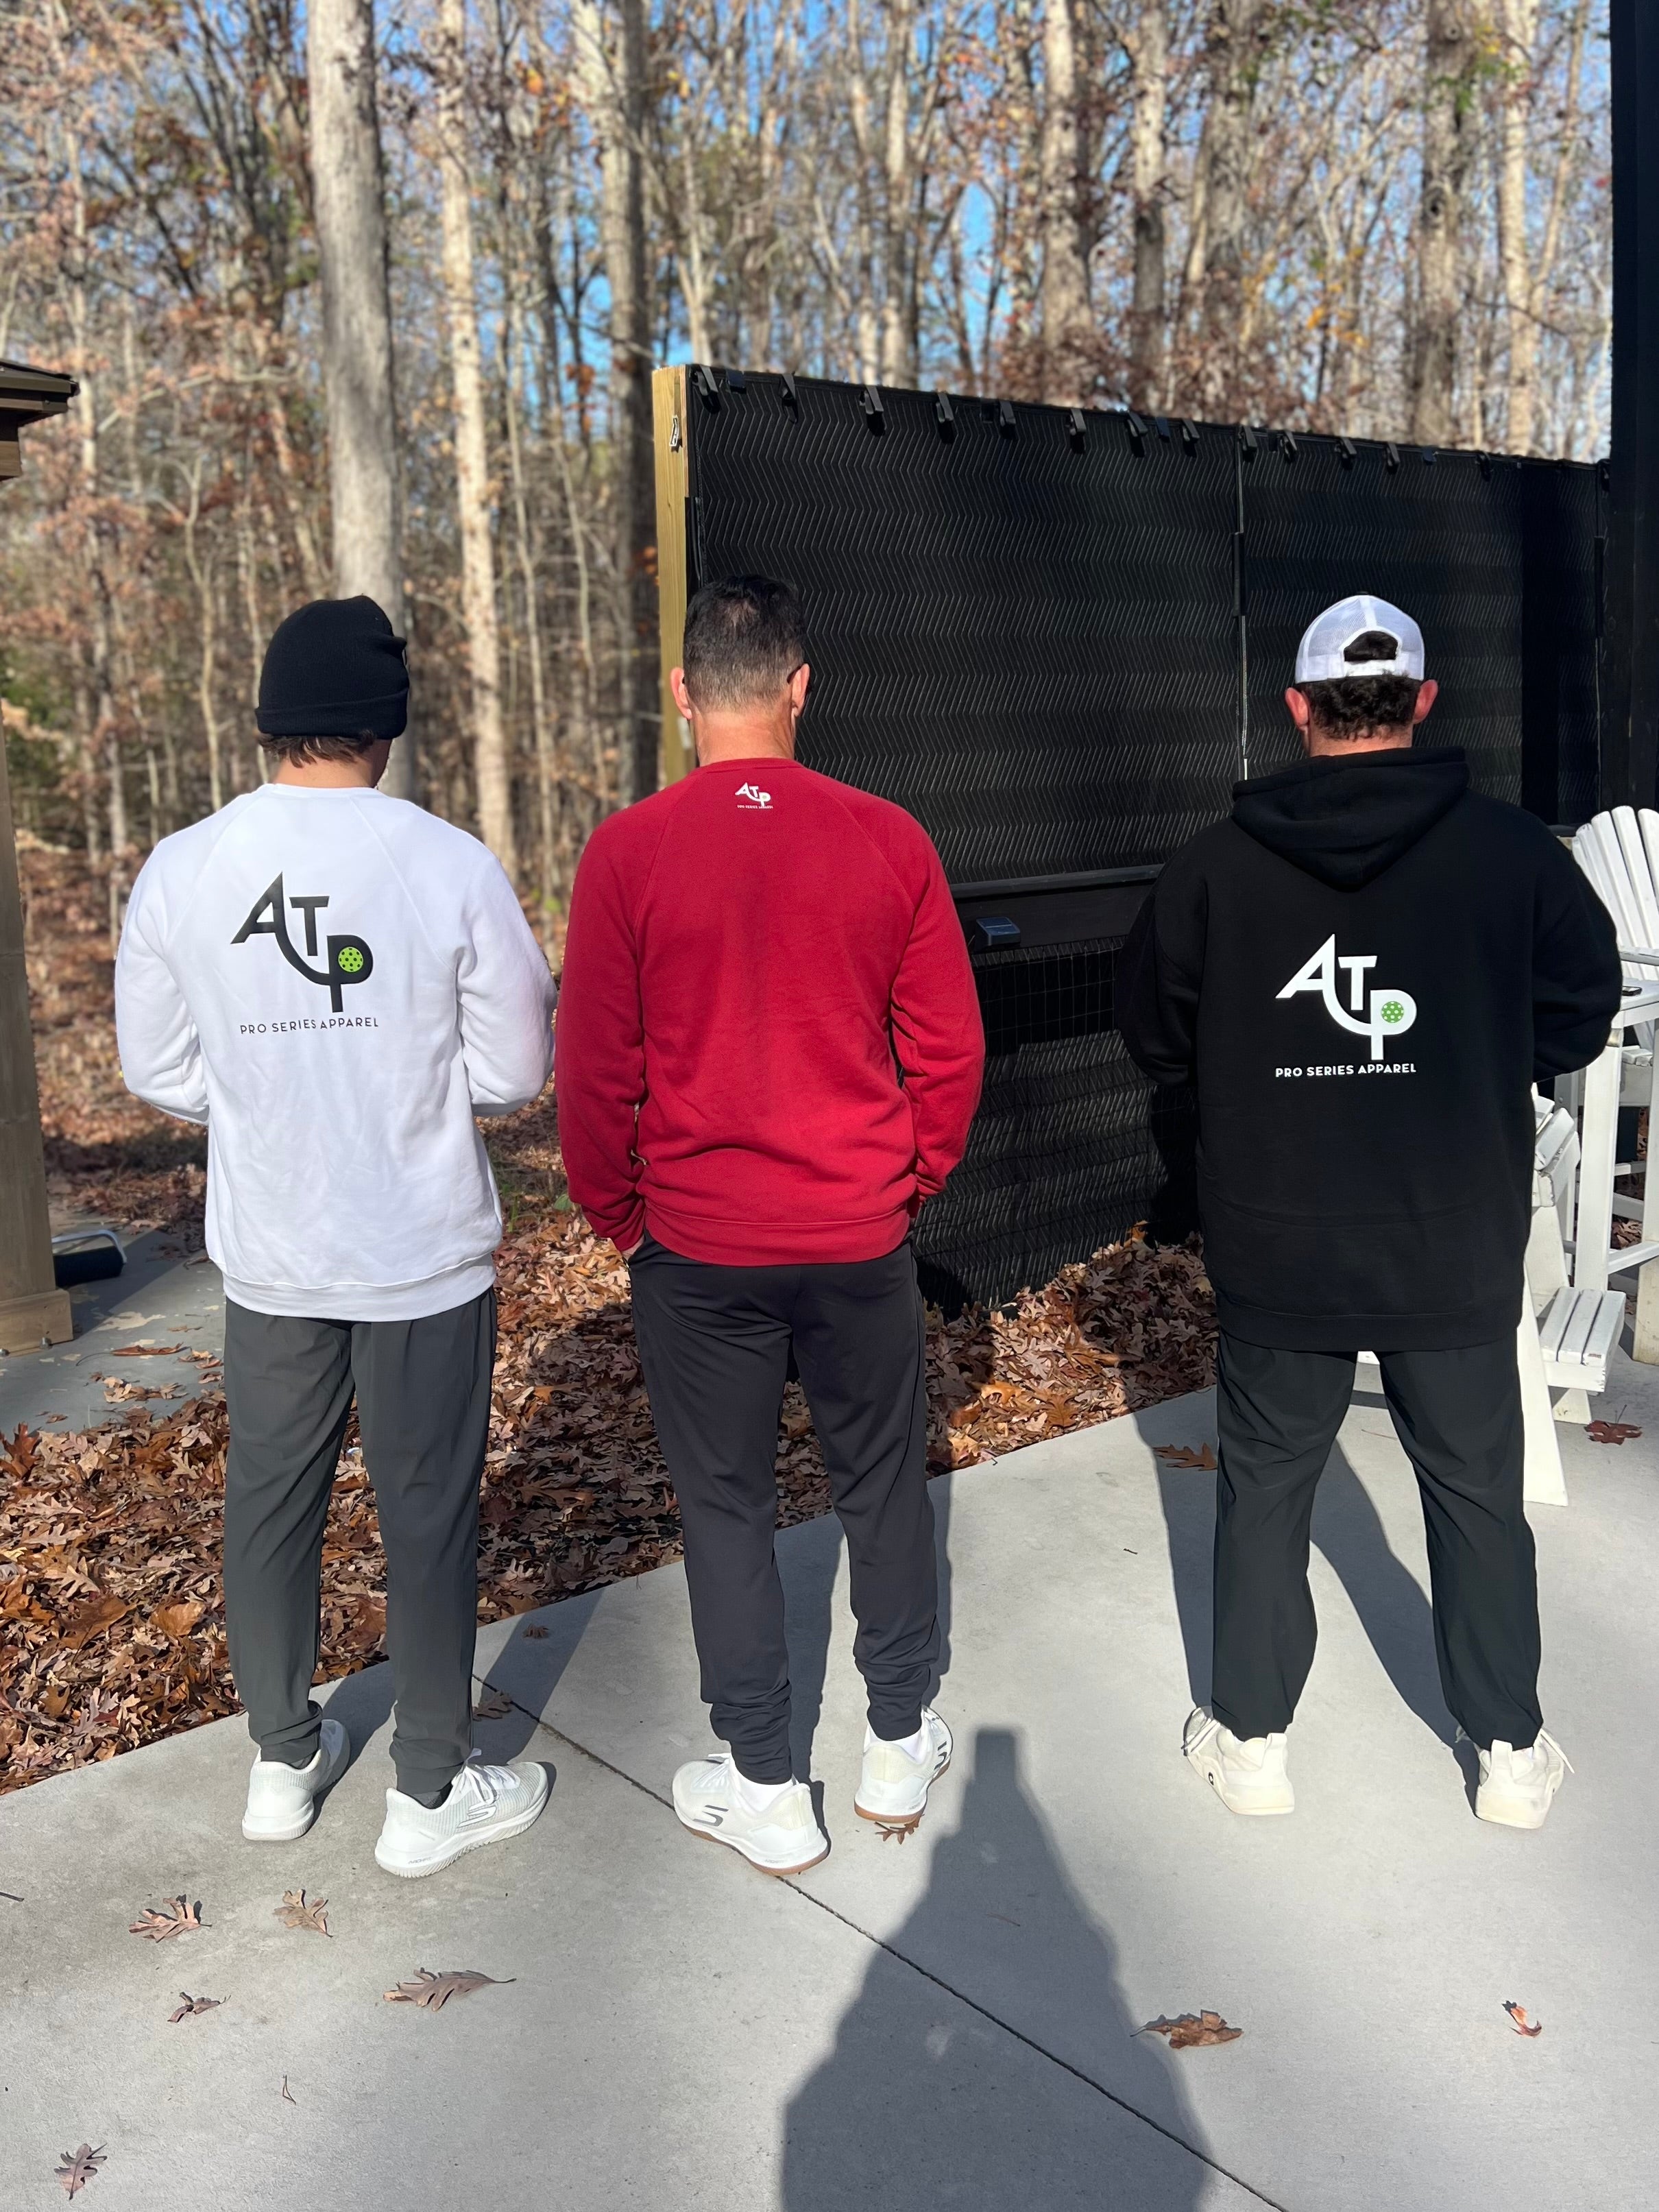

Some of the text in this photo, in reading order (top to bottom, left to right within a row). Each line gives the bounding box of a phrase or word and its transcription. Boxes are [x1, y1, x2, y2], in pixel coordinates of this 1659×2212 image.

[230, 871, 374, 1013] ATP
[240, 1017, 378, 1034] PRO SERIES APPAREL
[1275, 933, 1417, 1060] ATP
[1275, 1063, 1416, 1077] PRO SERIES APPAREL
